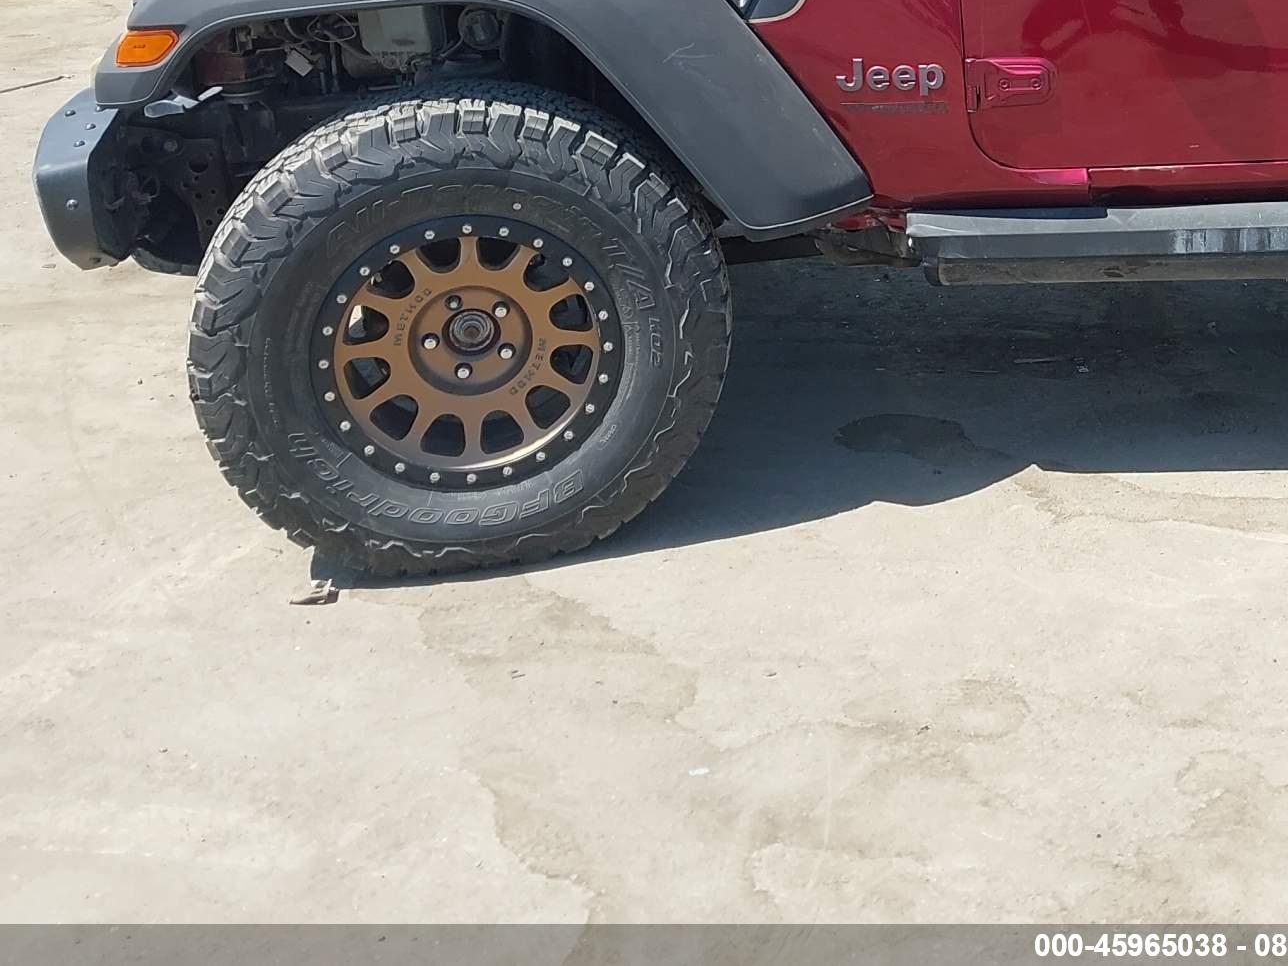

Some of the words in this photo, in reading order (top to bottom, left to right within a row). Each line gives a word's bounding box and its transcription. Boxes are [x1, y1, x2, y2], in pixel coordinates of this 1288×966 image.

[836, 58, 944, 96] Jeep
[394, 288, 433, 346] METHOD
[510, 337, 548, 395] METHOD
[287, 432, 584, 526] BFGoodrich
